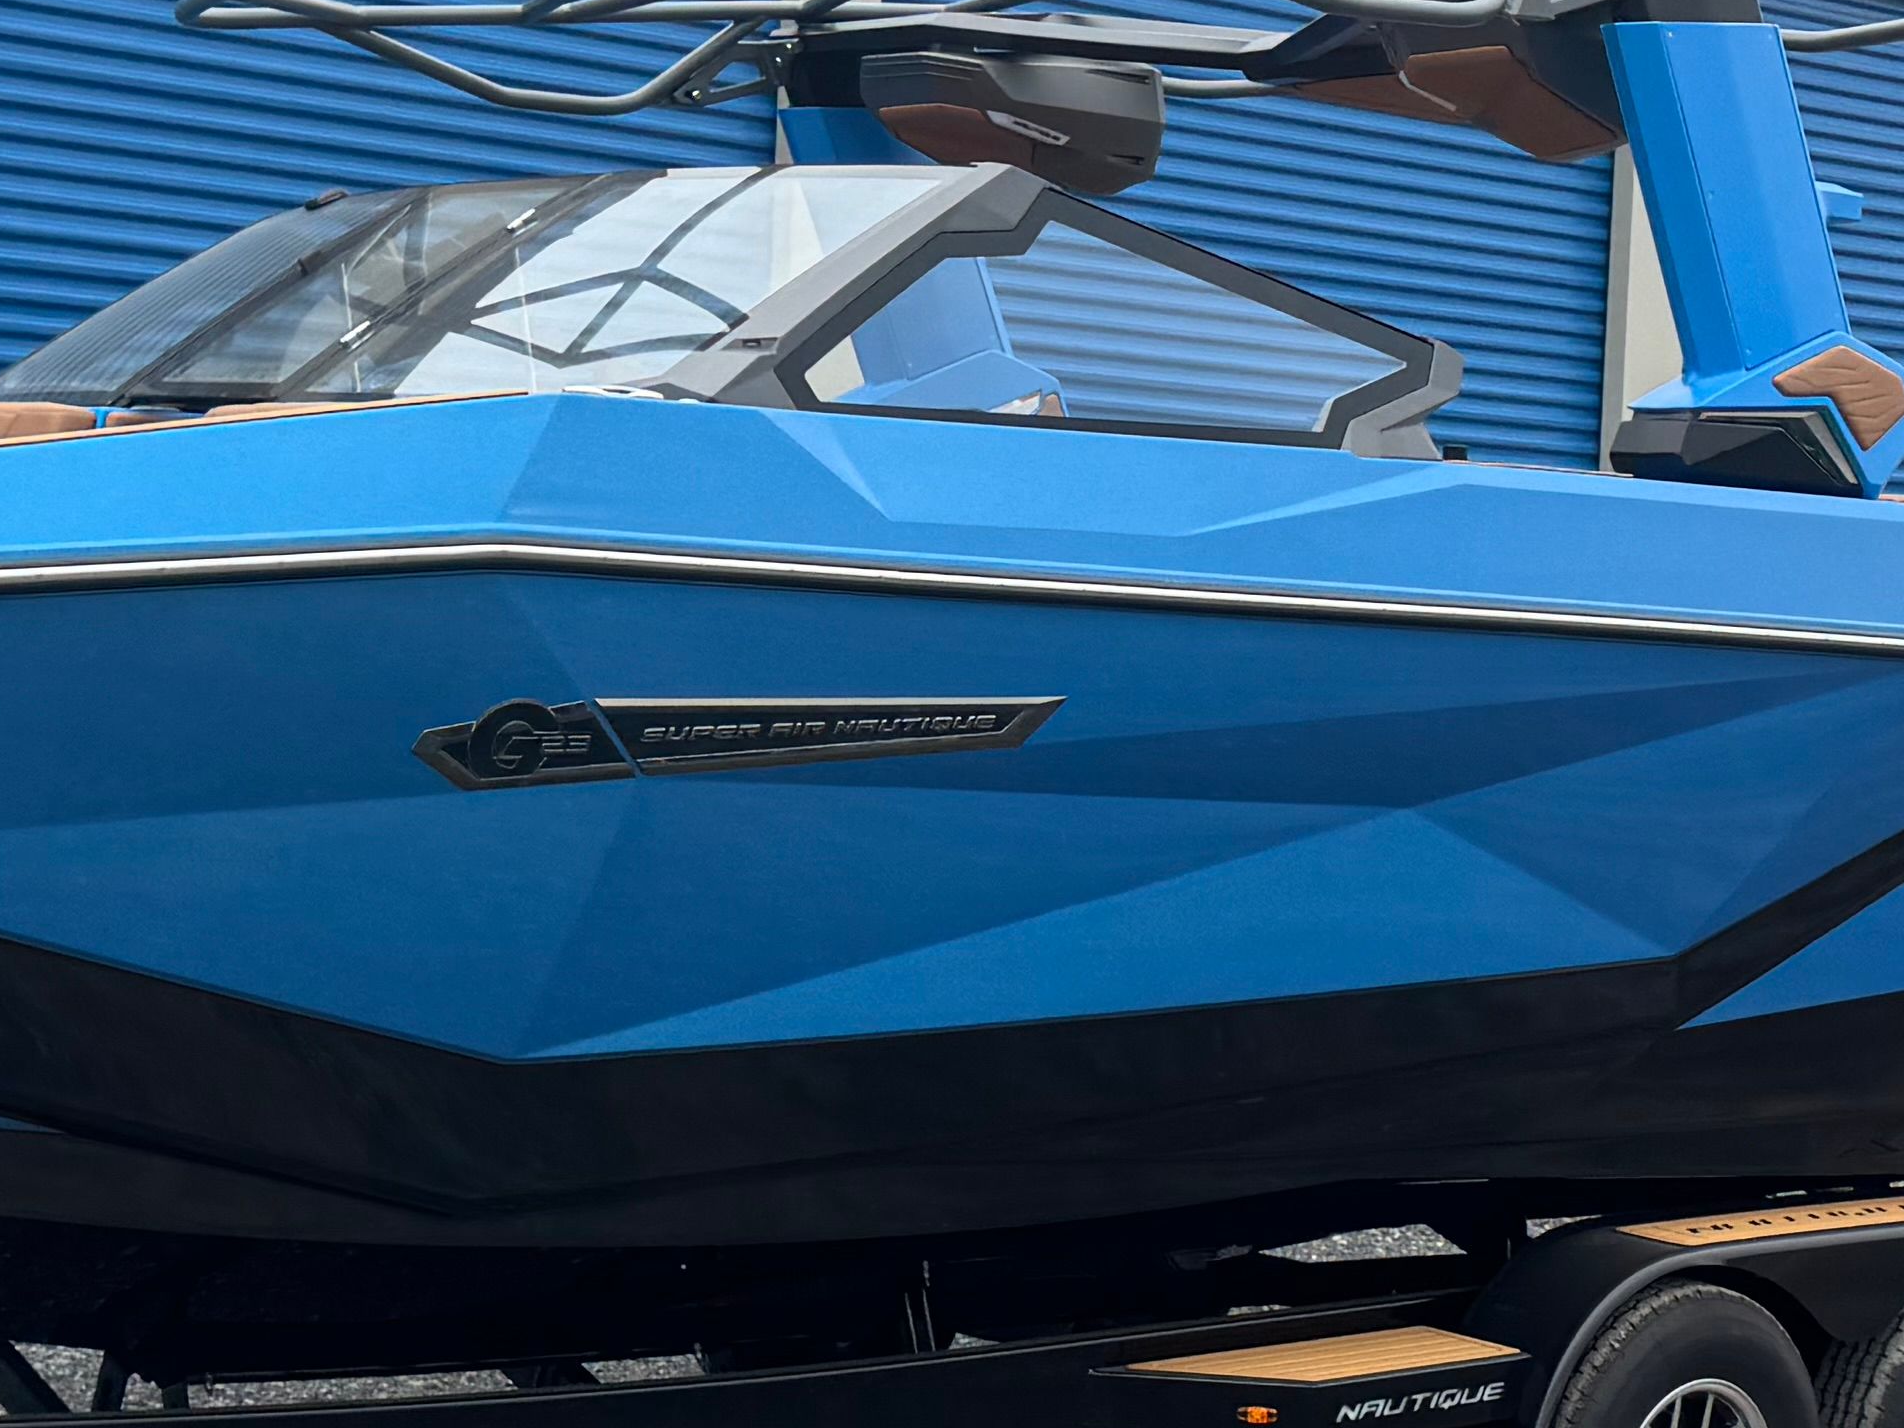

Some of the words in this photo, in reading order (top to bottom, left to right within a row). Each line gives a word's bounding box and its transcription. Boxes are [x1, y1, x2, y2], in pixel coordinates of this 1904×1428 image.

[640, 723, 762, 743] SUPER
[768, 721, 827, 739] AIR
[833, 714, 997, 735] NAUTIQUE
[1335, 1381, 1505, 1424] NAUTIQUE
